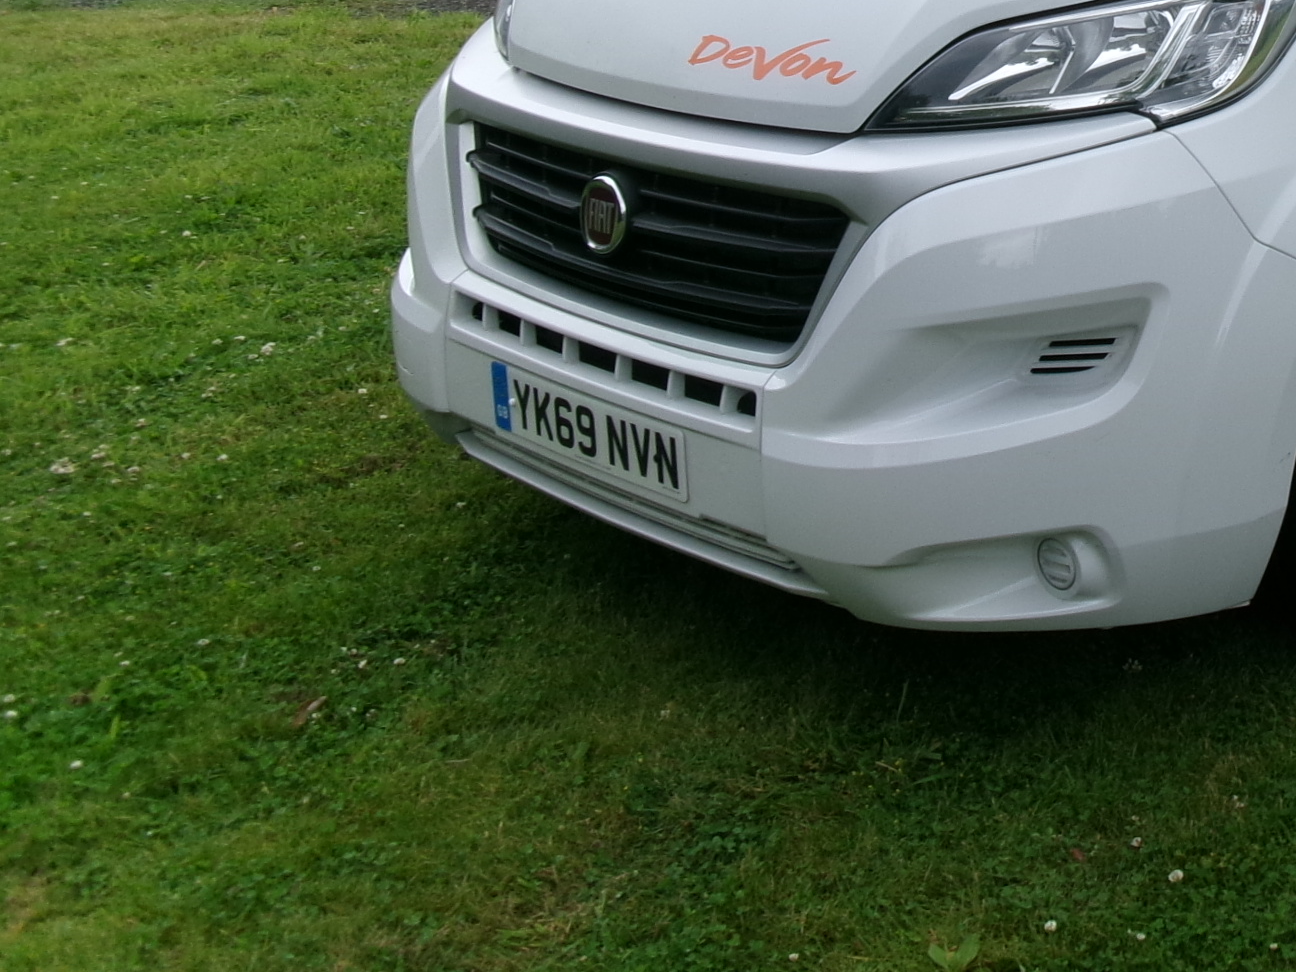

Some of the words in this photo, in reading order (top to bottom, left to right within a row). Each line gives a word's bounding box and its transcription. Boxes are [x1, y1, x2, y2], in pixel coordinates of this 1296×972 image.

[588, 197, 615, 234] FIAT
[513, 379, 598, 458] YK69
[605, 414, 680, 490] NVN
